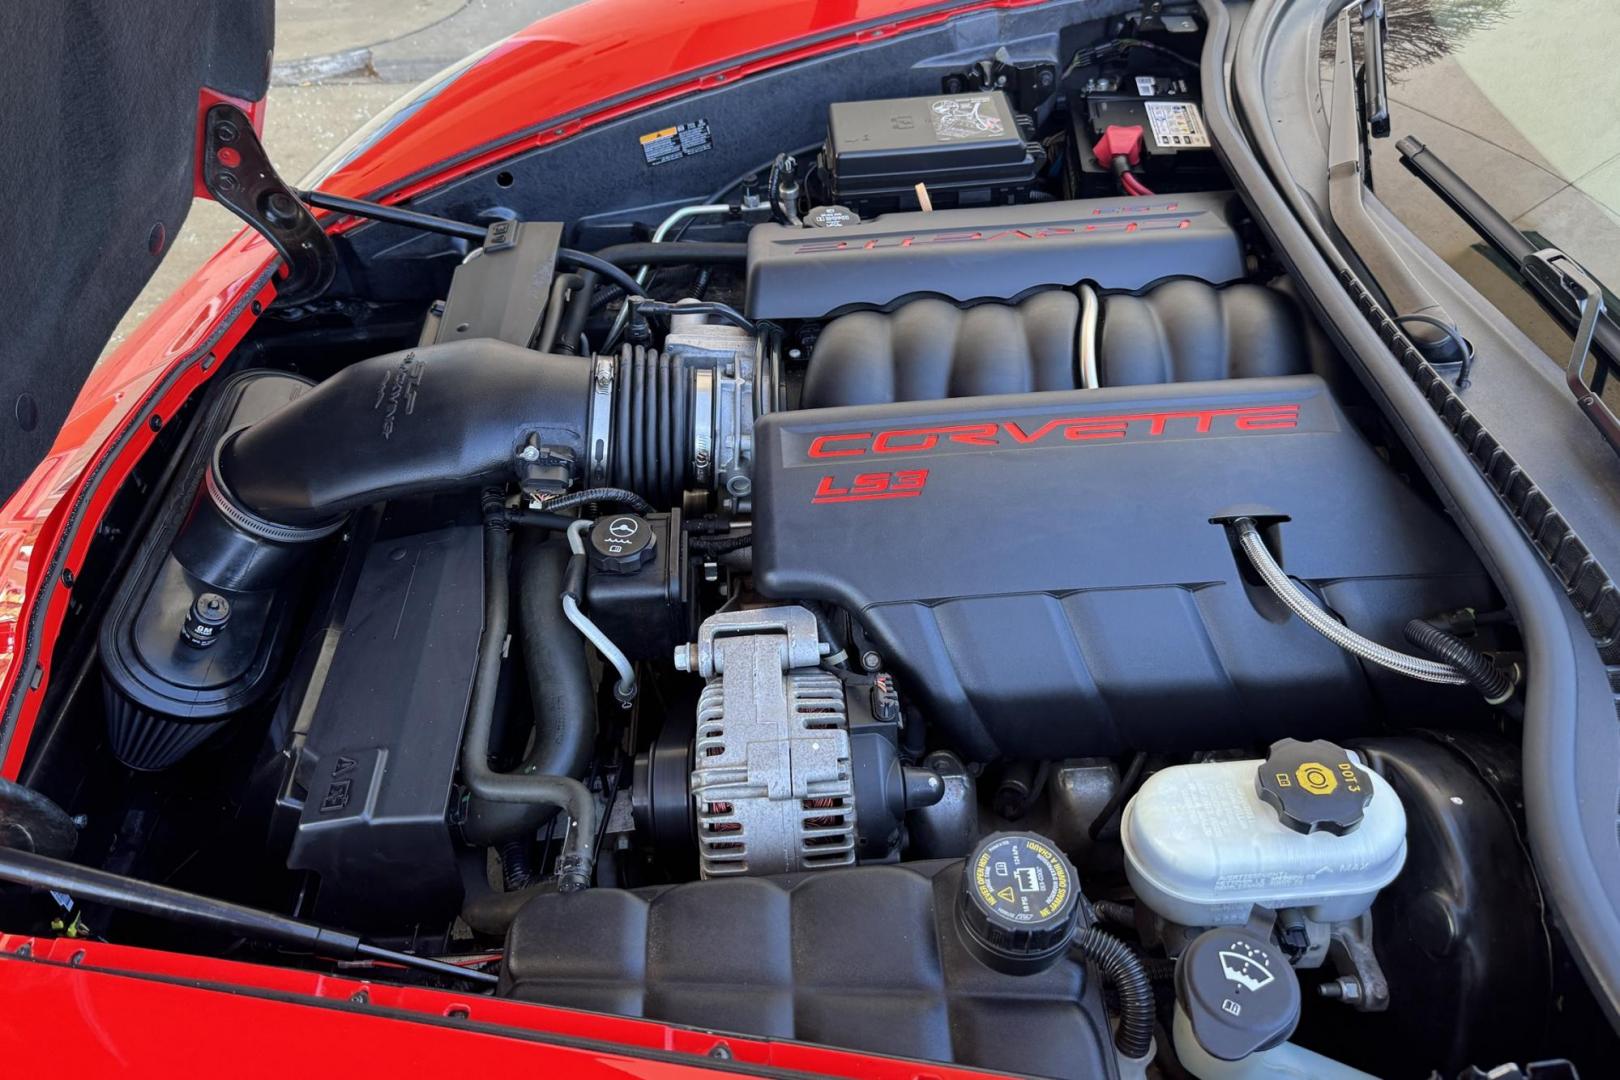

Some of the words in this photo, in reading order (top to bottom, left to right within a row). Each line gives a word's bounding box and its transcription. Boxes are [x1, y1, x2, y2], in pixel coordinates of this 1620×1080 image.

[807, 405, 1299, 459] CORVETTE
[815, 469, 930, 497] LS3
[1338, 763, 1358, 783] DOT
[1026, 841, 1051, 857] CHAUD!
[976, 867, 984, 884] OPEN
[1053, 863, 1066, 887] OUVRIR
[979, 884, 996, 905] NEVER
[1049, 888, 1066, 911] JAMAIS
